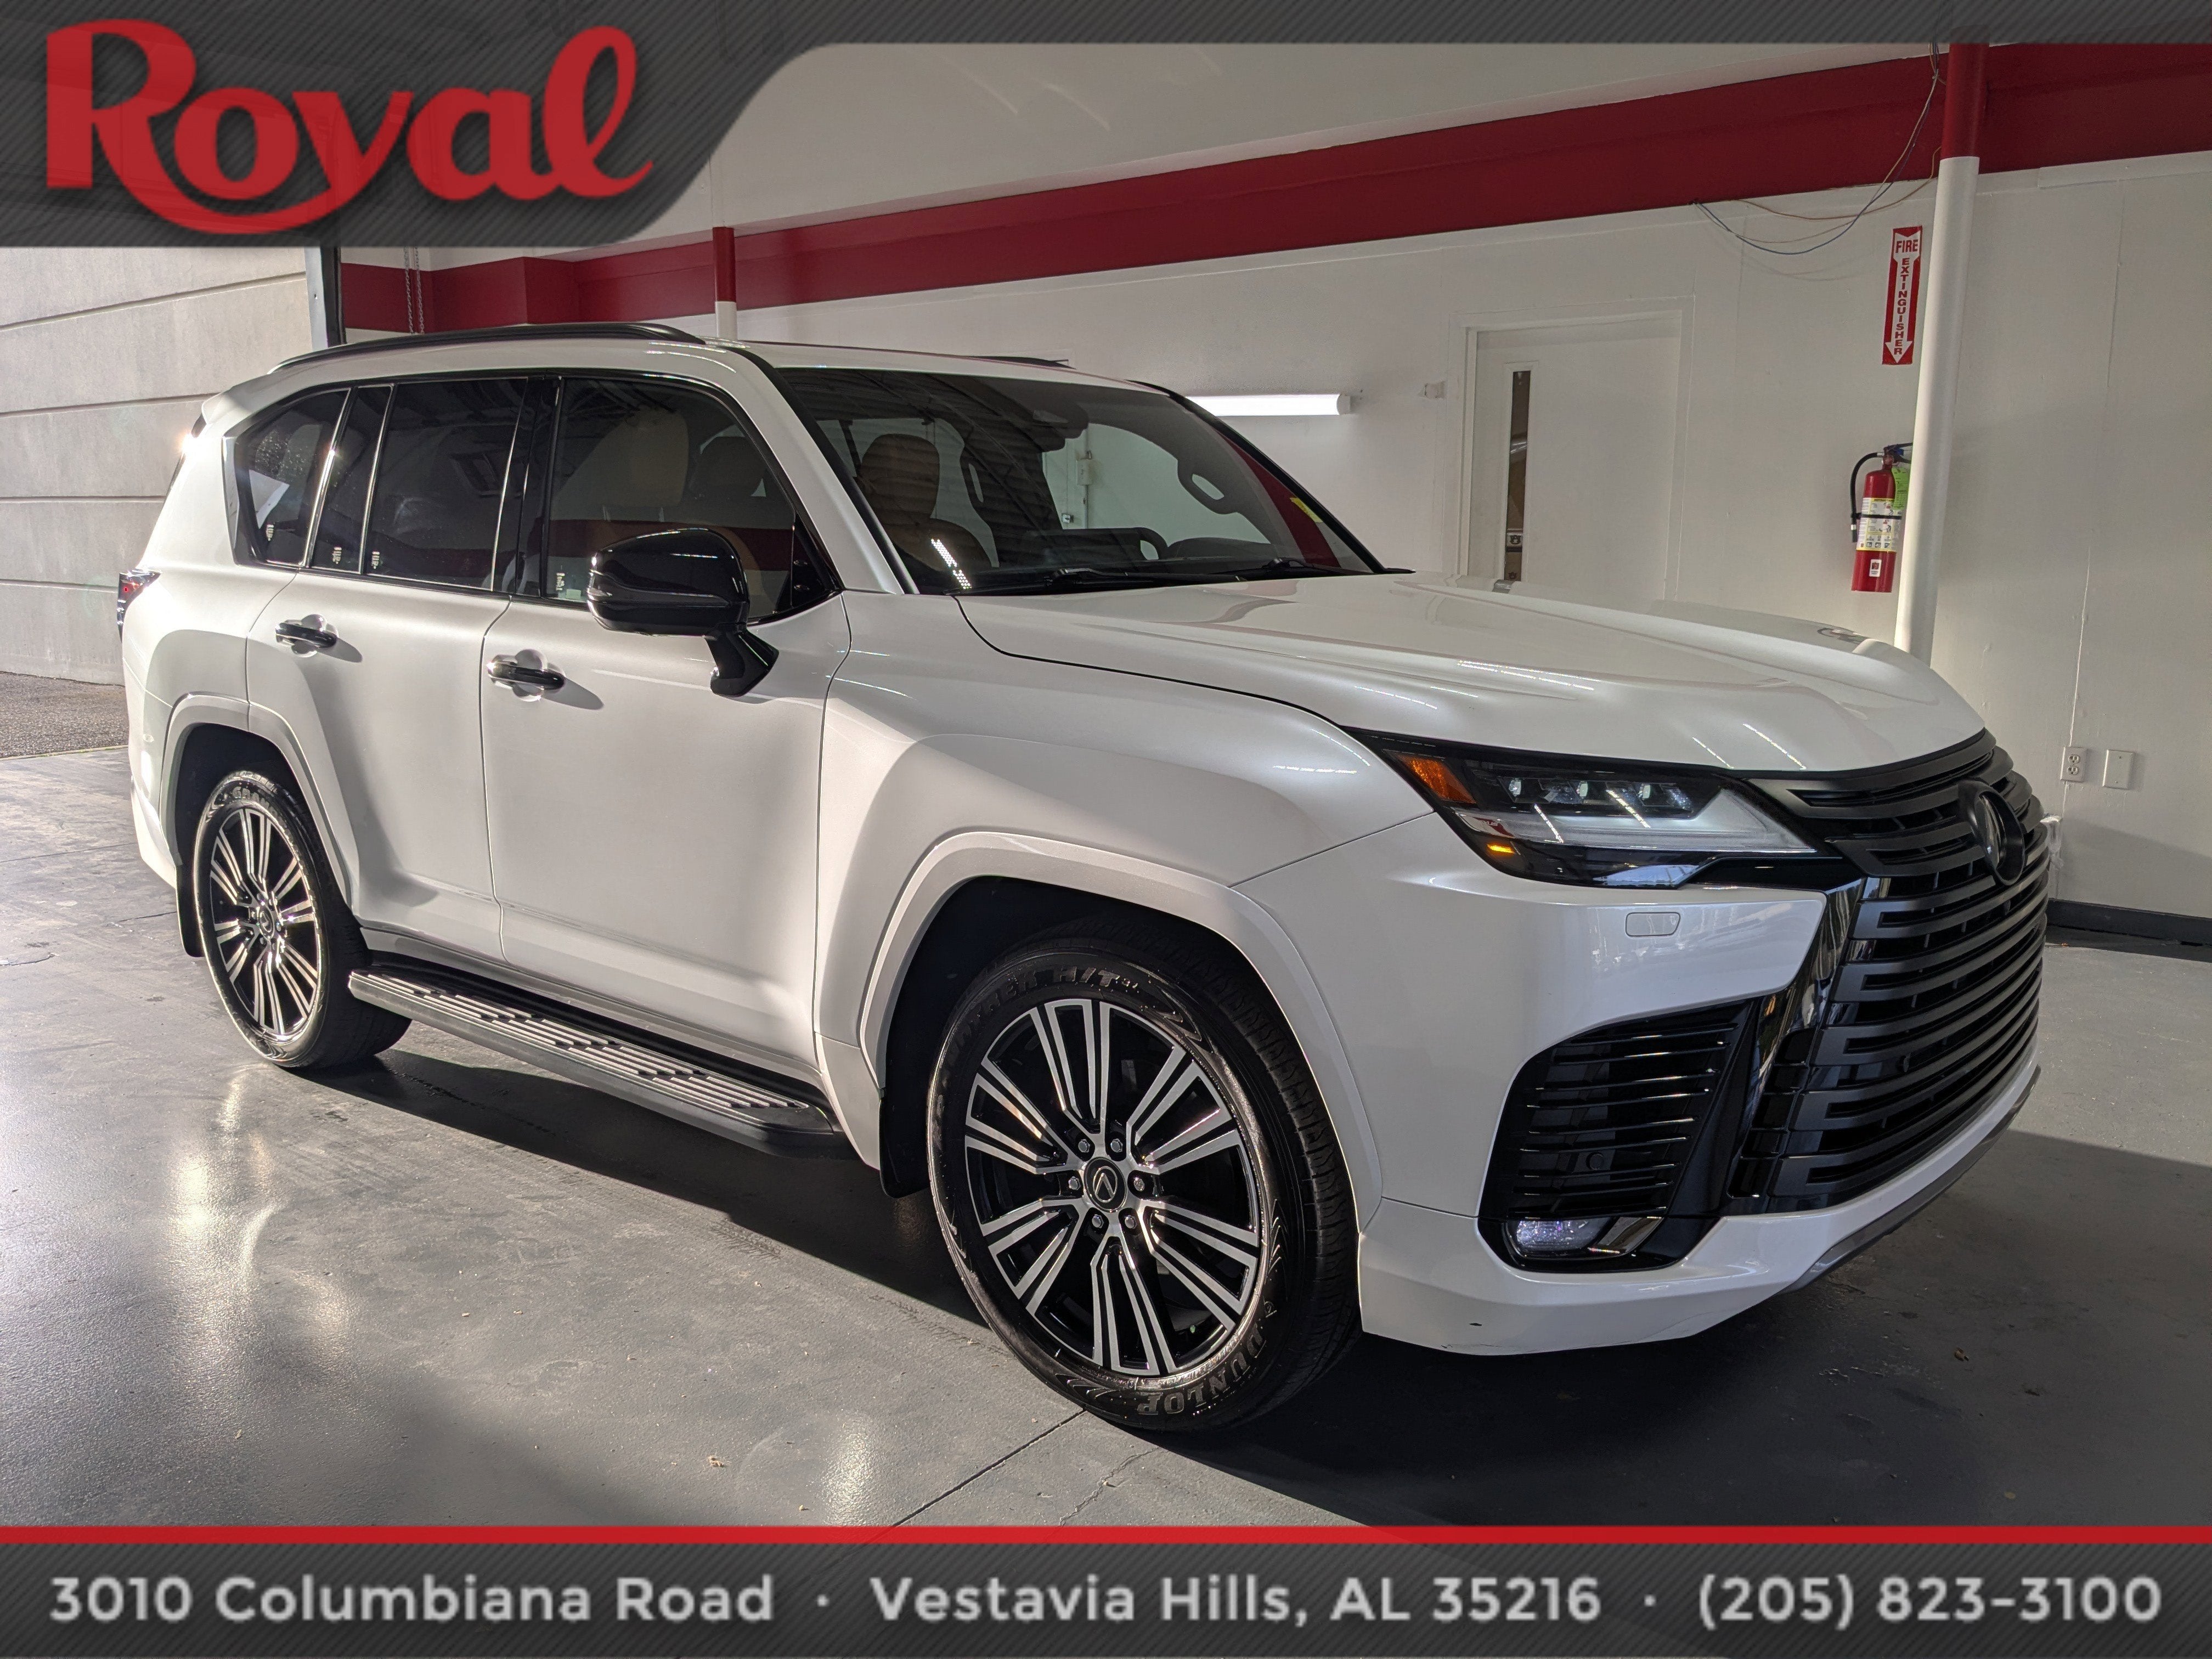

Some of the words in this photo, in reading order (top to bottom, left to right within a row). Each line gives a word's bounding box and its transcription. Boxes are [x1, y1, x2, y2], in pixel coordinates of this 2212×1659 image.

[1895, 239, 1919, 254] FIRE
[1893, 257, 1910, 356] EXTINGUISHER
[1136, 1321, 1268, 1417] DUNLOP
